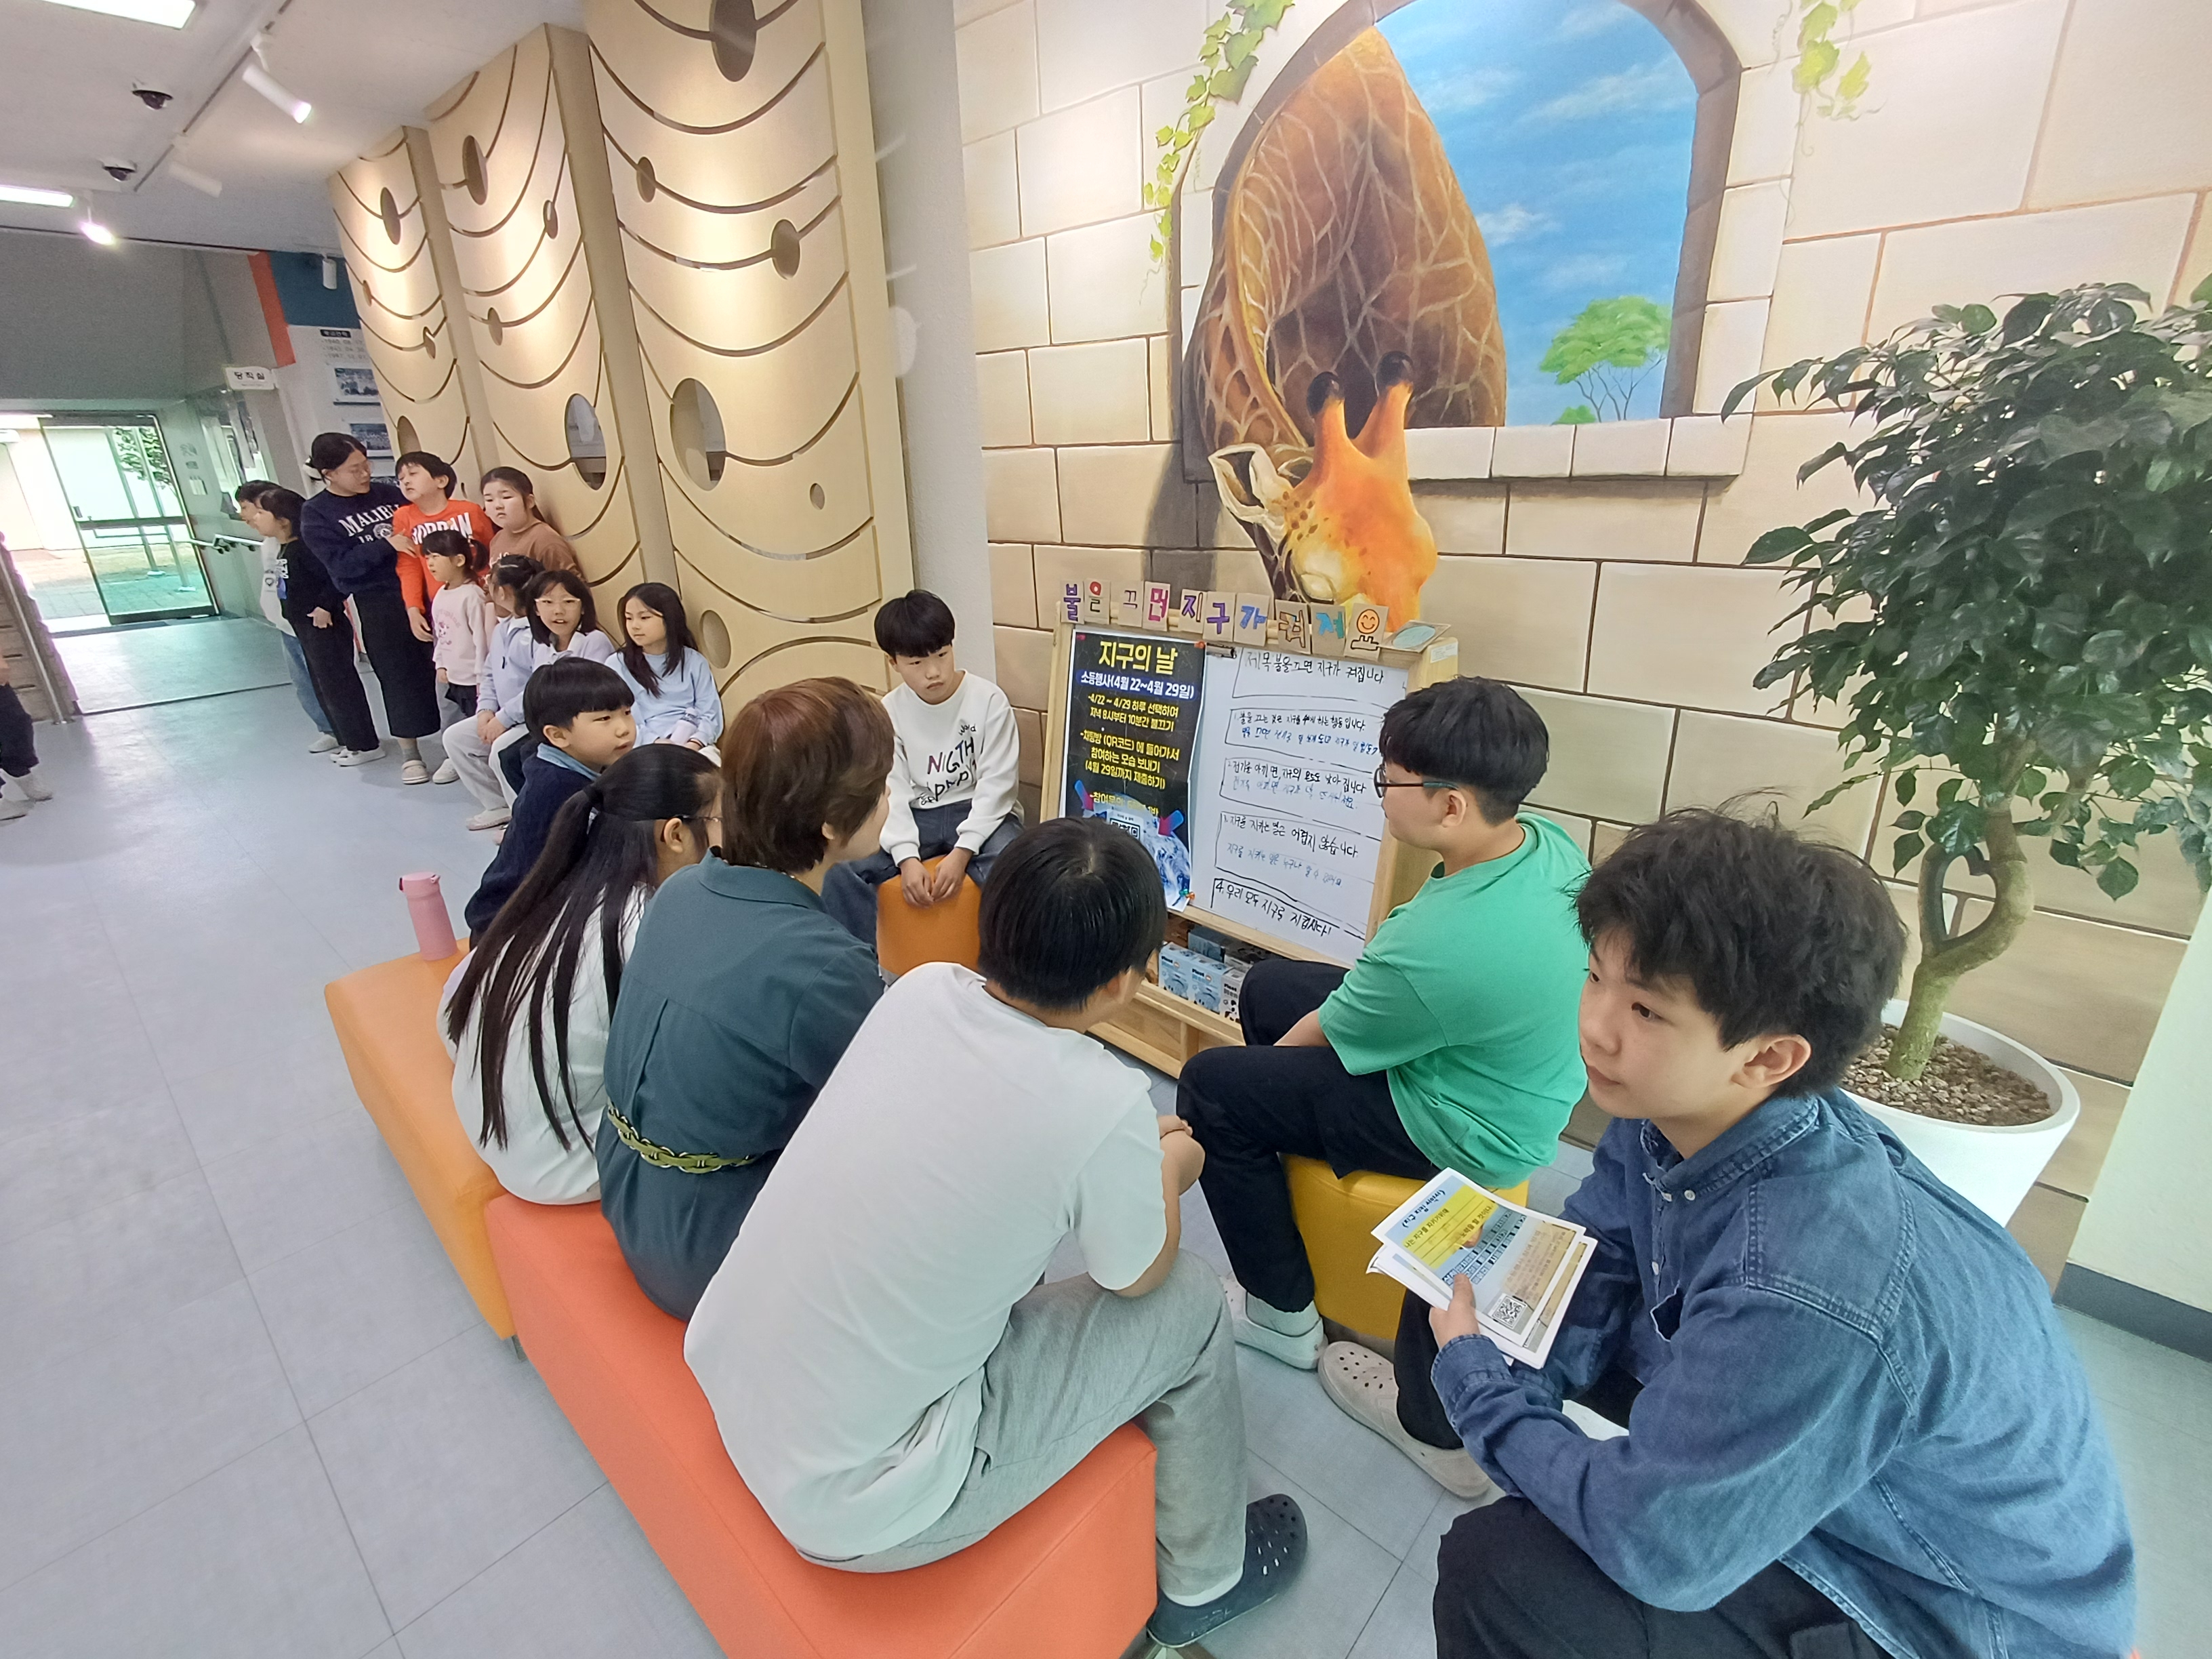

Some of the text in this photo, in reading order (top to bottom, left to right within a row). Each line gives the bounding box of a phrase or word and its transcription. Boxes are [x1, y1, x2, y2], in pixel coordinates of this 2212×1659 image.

[234, 371, 266, 380] 당직실
[1063, 581, 1103, 621] 불을
[1123, 588, 1169, 622] 끄면
[1181, 592, 1267, 635] 지구가
[1099, 640, 1179, 675] 지구의 날
[1273, 653, 1292, 673] 불을
[1291, 660, 1313, 674] 끄면
[1317, 659, 1341, 677] 지구가
[1081, 670, 1195, 699] 소등행사(4월 22~4월 29일)
[1090, 707, 1174, 732] 저녁 8시부터 10분간 불끄기
[1113, 697, 1130, 710] 4/29
[1132, 700, 1146, 712] 하루
[1147, 703, 1179, 718] 선택하여
[1240, 711, 1252, 725] 불을
[1254, 714, 1269, 724] 끄는
[1090, 746, 1160, 773] 참여하는 모습 보내기
[1103, 735, 1134, 751] (QR코드)
[1136, 741, 1144, 754] 에
[1146, 743, 1180, 761] 들어가서
[1085, 760, 1166, 790] (4월 29일까지 제출하기)
[1233, 760, 1252, 774] 전기를
[1282, 767, 1302, 782] 지구의
[1229, 815, 1247, 830] 지구를
[1292, 827, 1316, 853] 어렵지
[1227, 884, 1244, 899] 우리
[1245, 890, 1260, 907] 모두
[1261, 899, 1286, 922] 지구를
[1404, 1239, 1416, 1248] 나는
